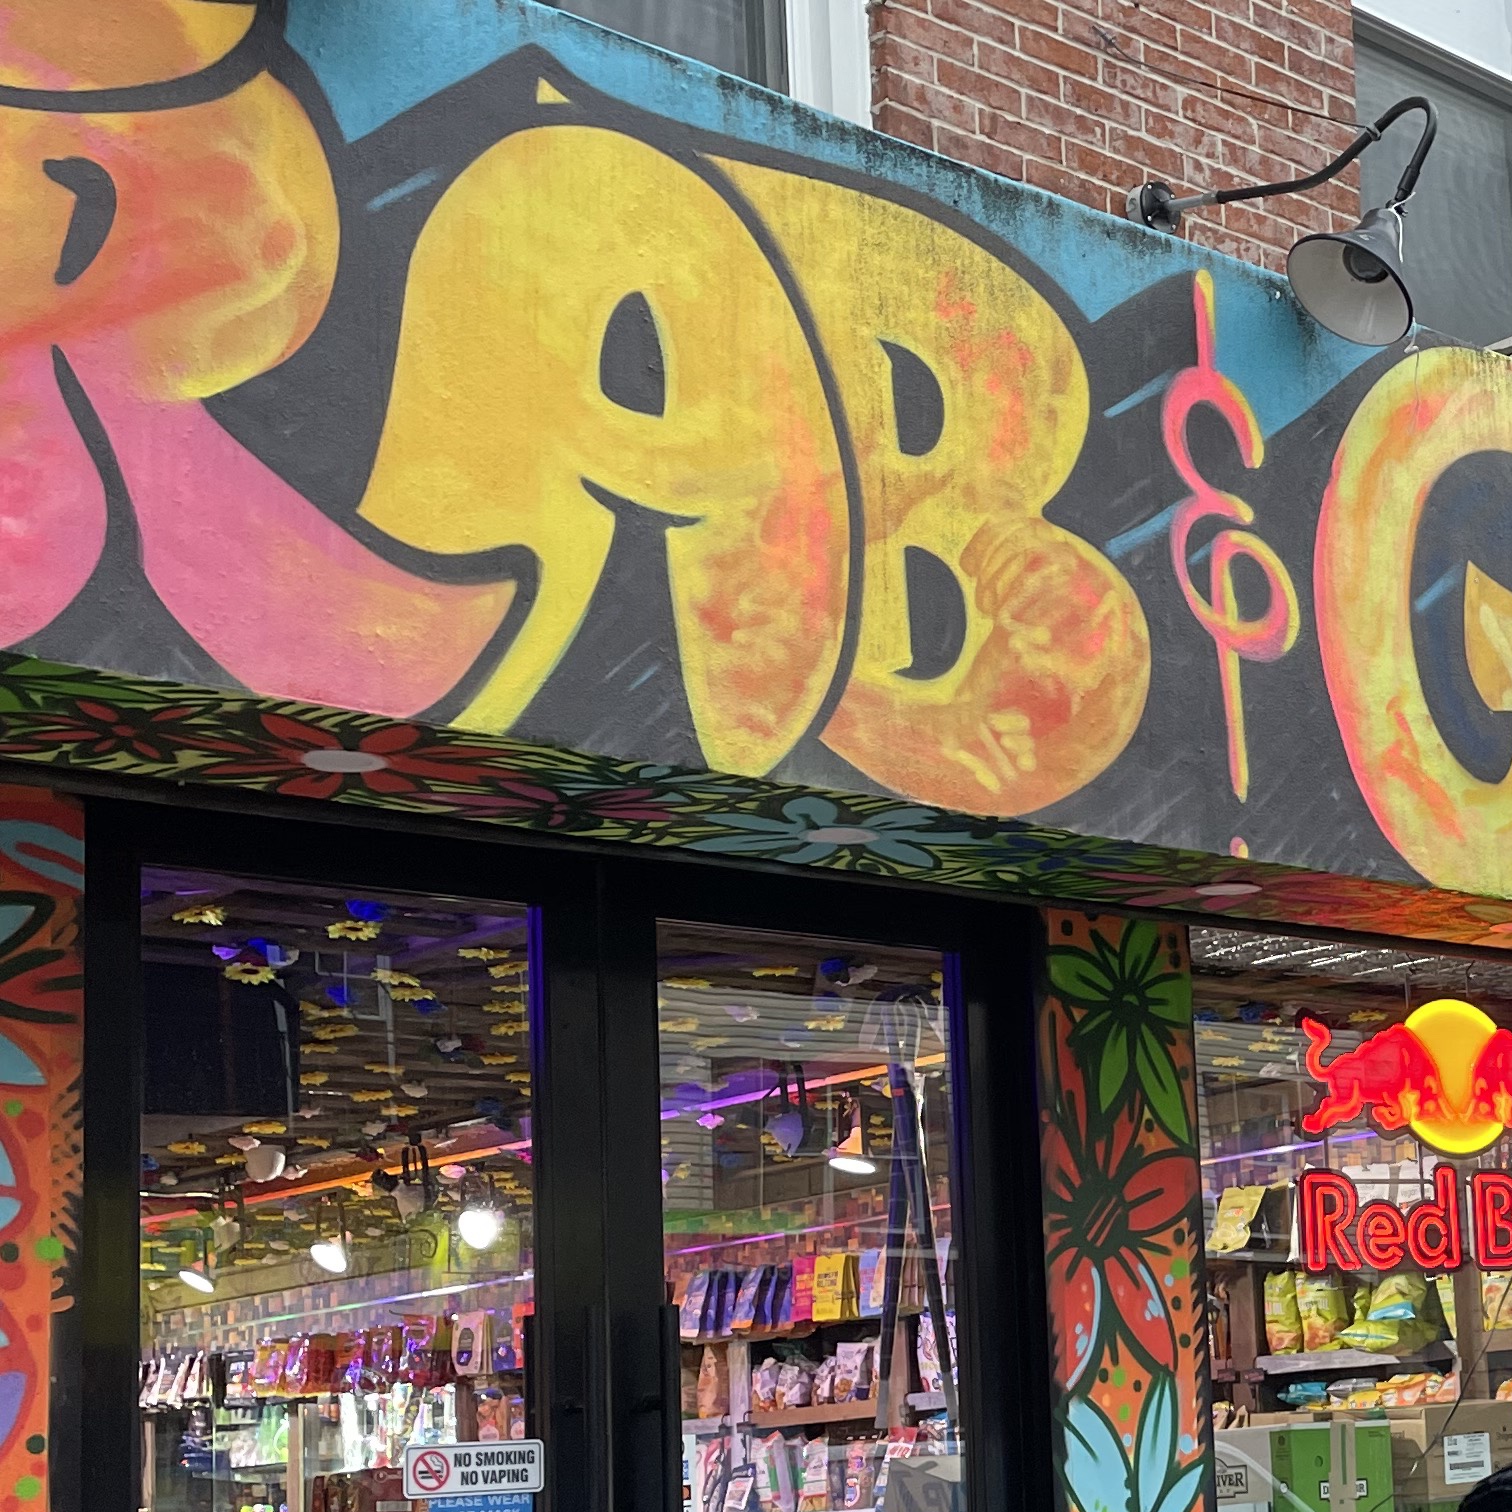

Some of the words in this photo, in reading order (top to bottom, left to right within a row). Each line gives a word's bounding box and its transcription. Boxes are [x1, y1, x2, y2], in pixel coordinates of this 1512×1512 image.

[1300, 1165, 1464, 1272] Red
[453, 1452, 471, 1467] NO
[475, 1450, 535, 1466] SMOKING
[461, 1470, 478, 1486] NO
[481, 1468, 529, 1485] VAPING
[429, 1495, 483, 1508] PLEASE
[488, 1494, 530, 1506] WEAR
